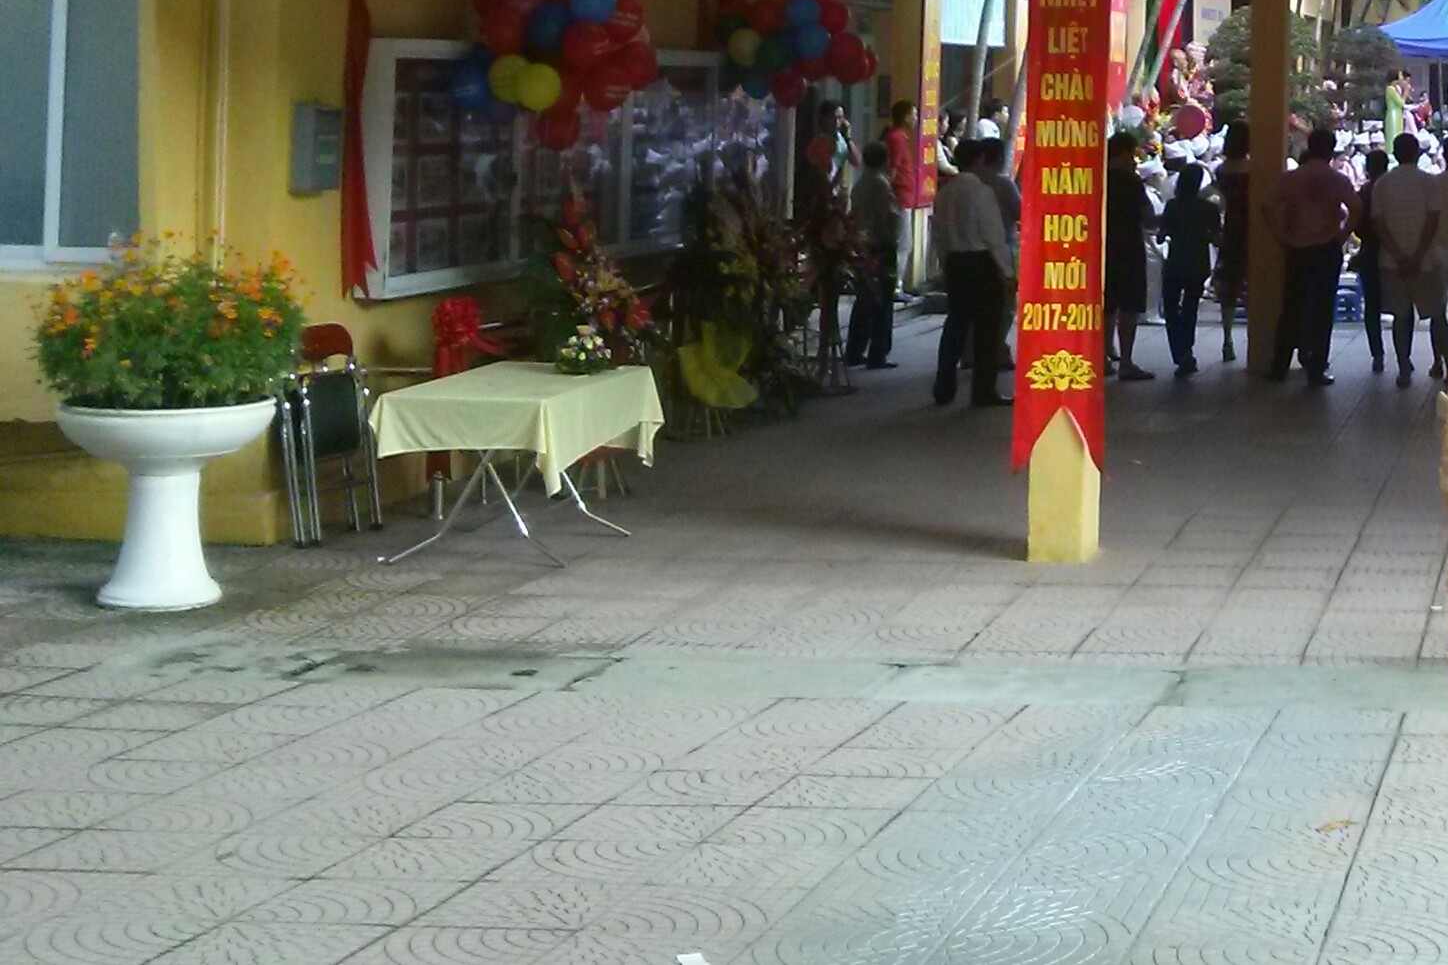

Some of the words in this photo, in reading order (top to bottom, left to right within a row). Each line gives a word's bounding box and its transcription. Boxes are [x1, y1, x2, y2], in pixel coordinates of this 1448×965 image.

[1047, 21, 1088, 59] LIỆT
[1035, 114, 1099, 148] MỪNG
[1041, 162, 1093, 195] NĂM
[1044, 214, 1089, 249] HỌC
[1044, 256, 1087, 290] MỚI
